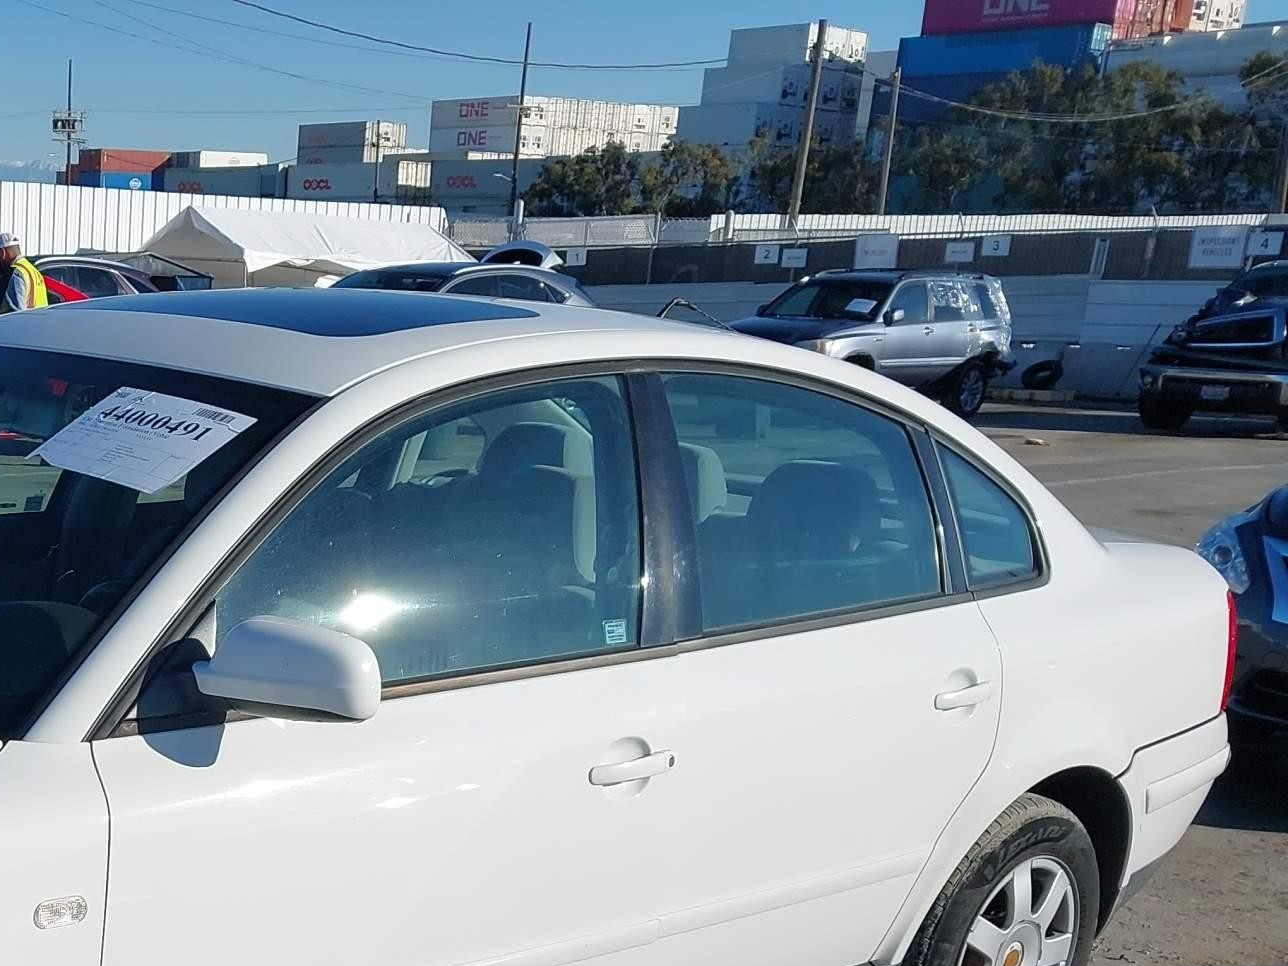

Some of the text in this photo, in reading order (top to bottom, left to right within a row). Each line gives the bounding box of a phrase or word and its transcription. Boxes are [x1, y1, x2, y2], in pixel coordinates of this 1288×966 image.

[459, 102, 489, 118] ONE
[457, 130, 487, 147] ONE
[303, 178, 332, 191] OOCL
[992, 240, 1000, 251] 3
[1260, 238, 1269, 249] 4
[763, 249, 770, 259] 2
[100, 405, 213, 441] 44000491
